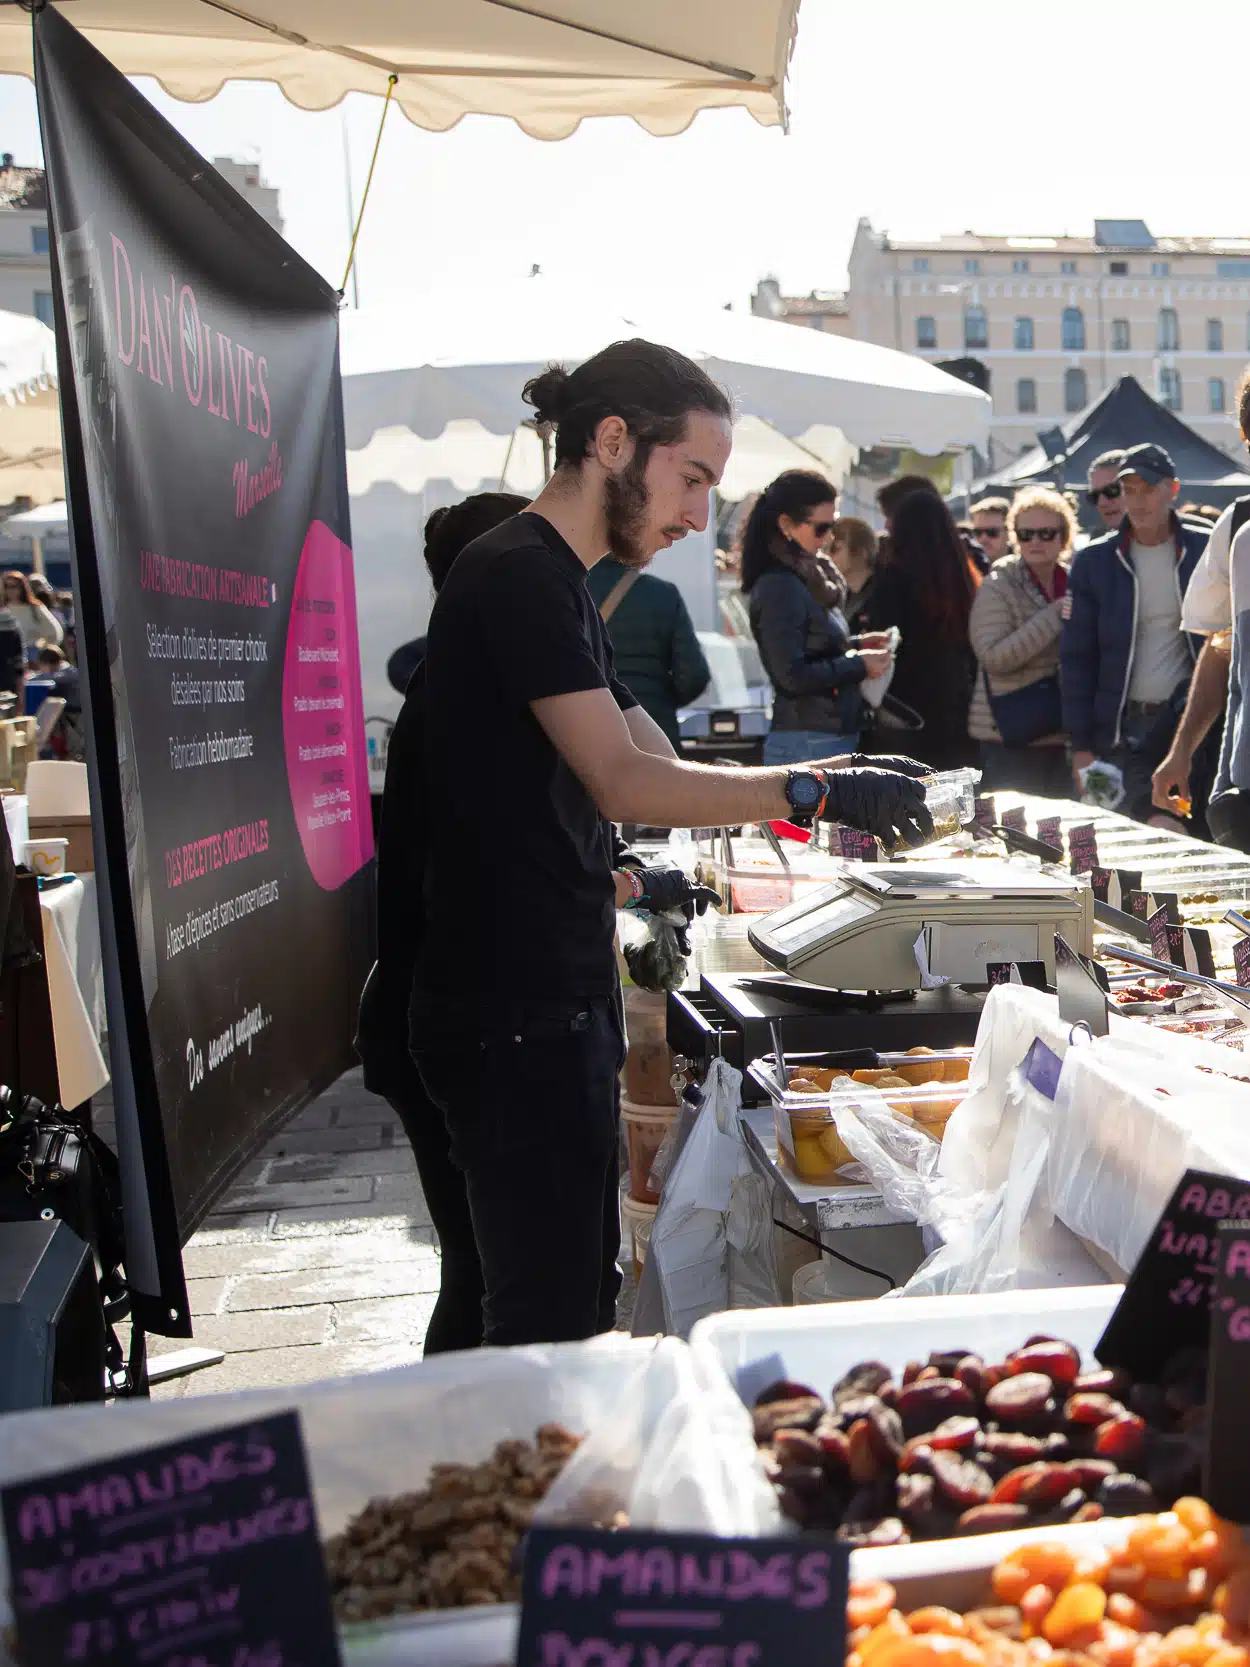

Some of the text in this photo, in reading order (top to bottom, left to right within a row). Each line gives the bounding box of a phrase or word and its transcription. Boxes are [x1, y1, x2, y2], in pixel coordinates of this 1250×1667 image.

[140, 551, 160, 592] UNE
[161, 555, 218, 600] FABRICATION
[219, 569, 270, 608] ARTISANALE
[146, 622, 268, 668] Sélection d'olives de premier choix
[171, 673, 245, 711] désalées par nos soins
[168, 728, 254, 770] Fabrication hebdomadaire
[165, 820, 270, 889] DES RECETTES ORIGINALES
[186, 907, 213, 949] d'épices
[212, 900, 220, 931] et
[219, 898, 235, 927] sans
[235, 879, 279, 918] conservateurs
[186, 1037, 205, 1092] Des
[18, 1440, 276, 1543] AMANDES
[541, 1544, 830, 1609] AMANDES
